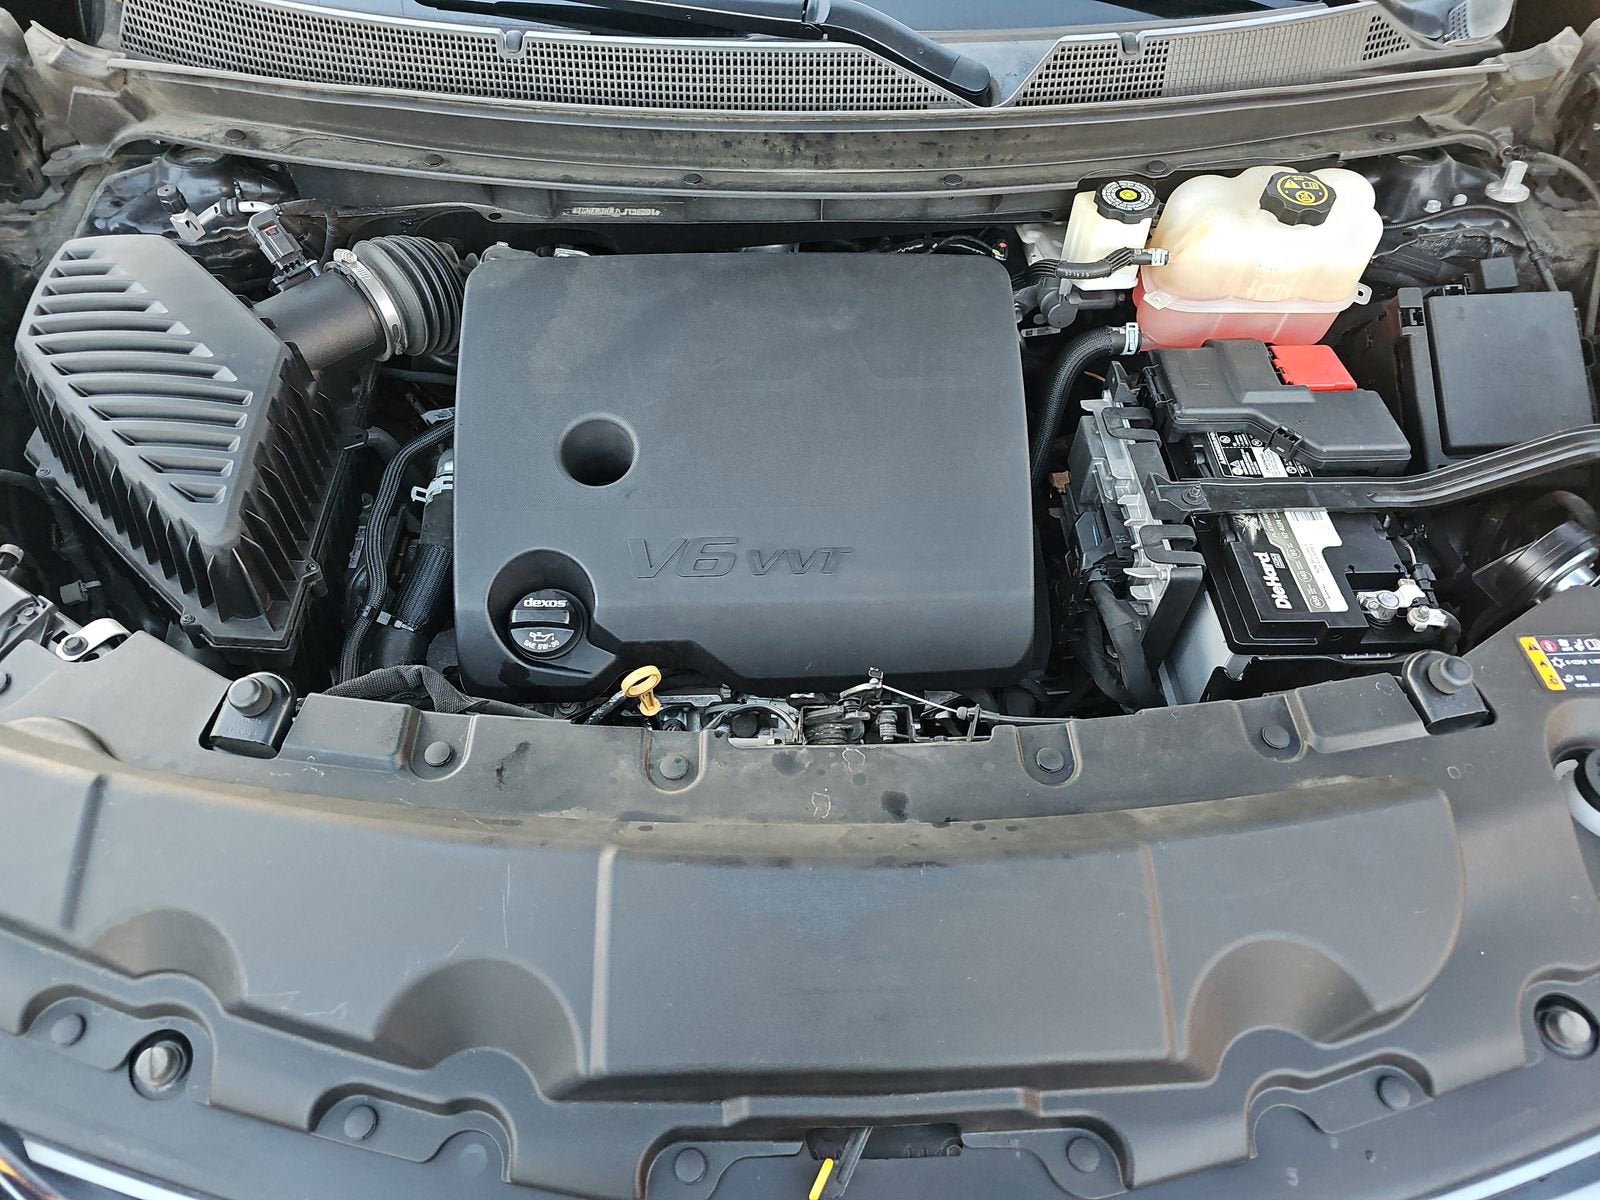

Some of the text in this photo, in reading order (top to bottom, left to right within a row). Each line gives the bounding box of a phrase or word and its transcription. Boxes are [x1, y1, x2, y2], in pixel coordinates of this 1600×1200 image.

[625, 536, 853, 578] V6 VVT
[1253, 552, 1292, 609] DieHard
[523, 597, 568, 608] dexos
[523, 639, 536, 650] SAE
